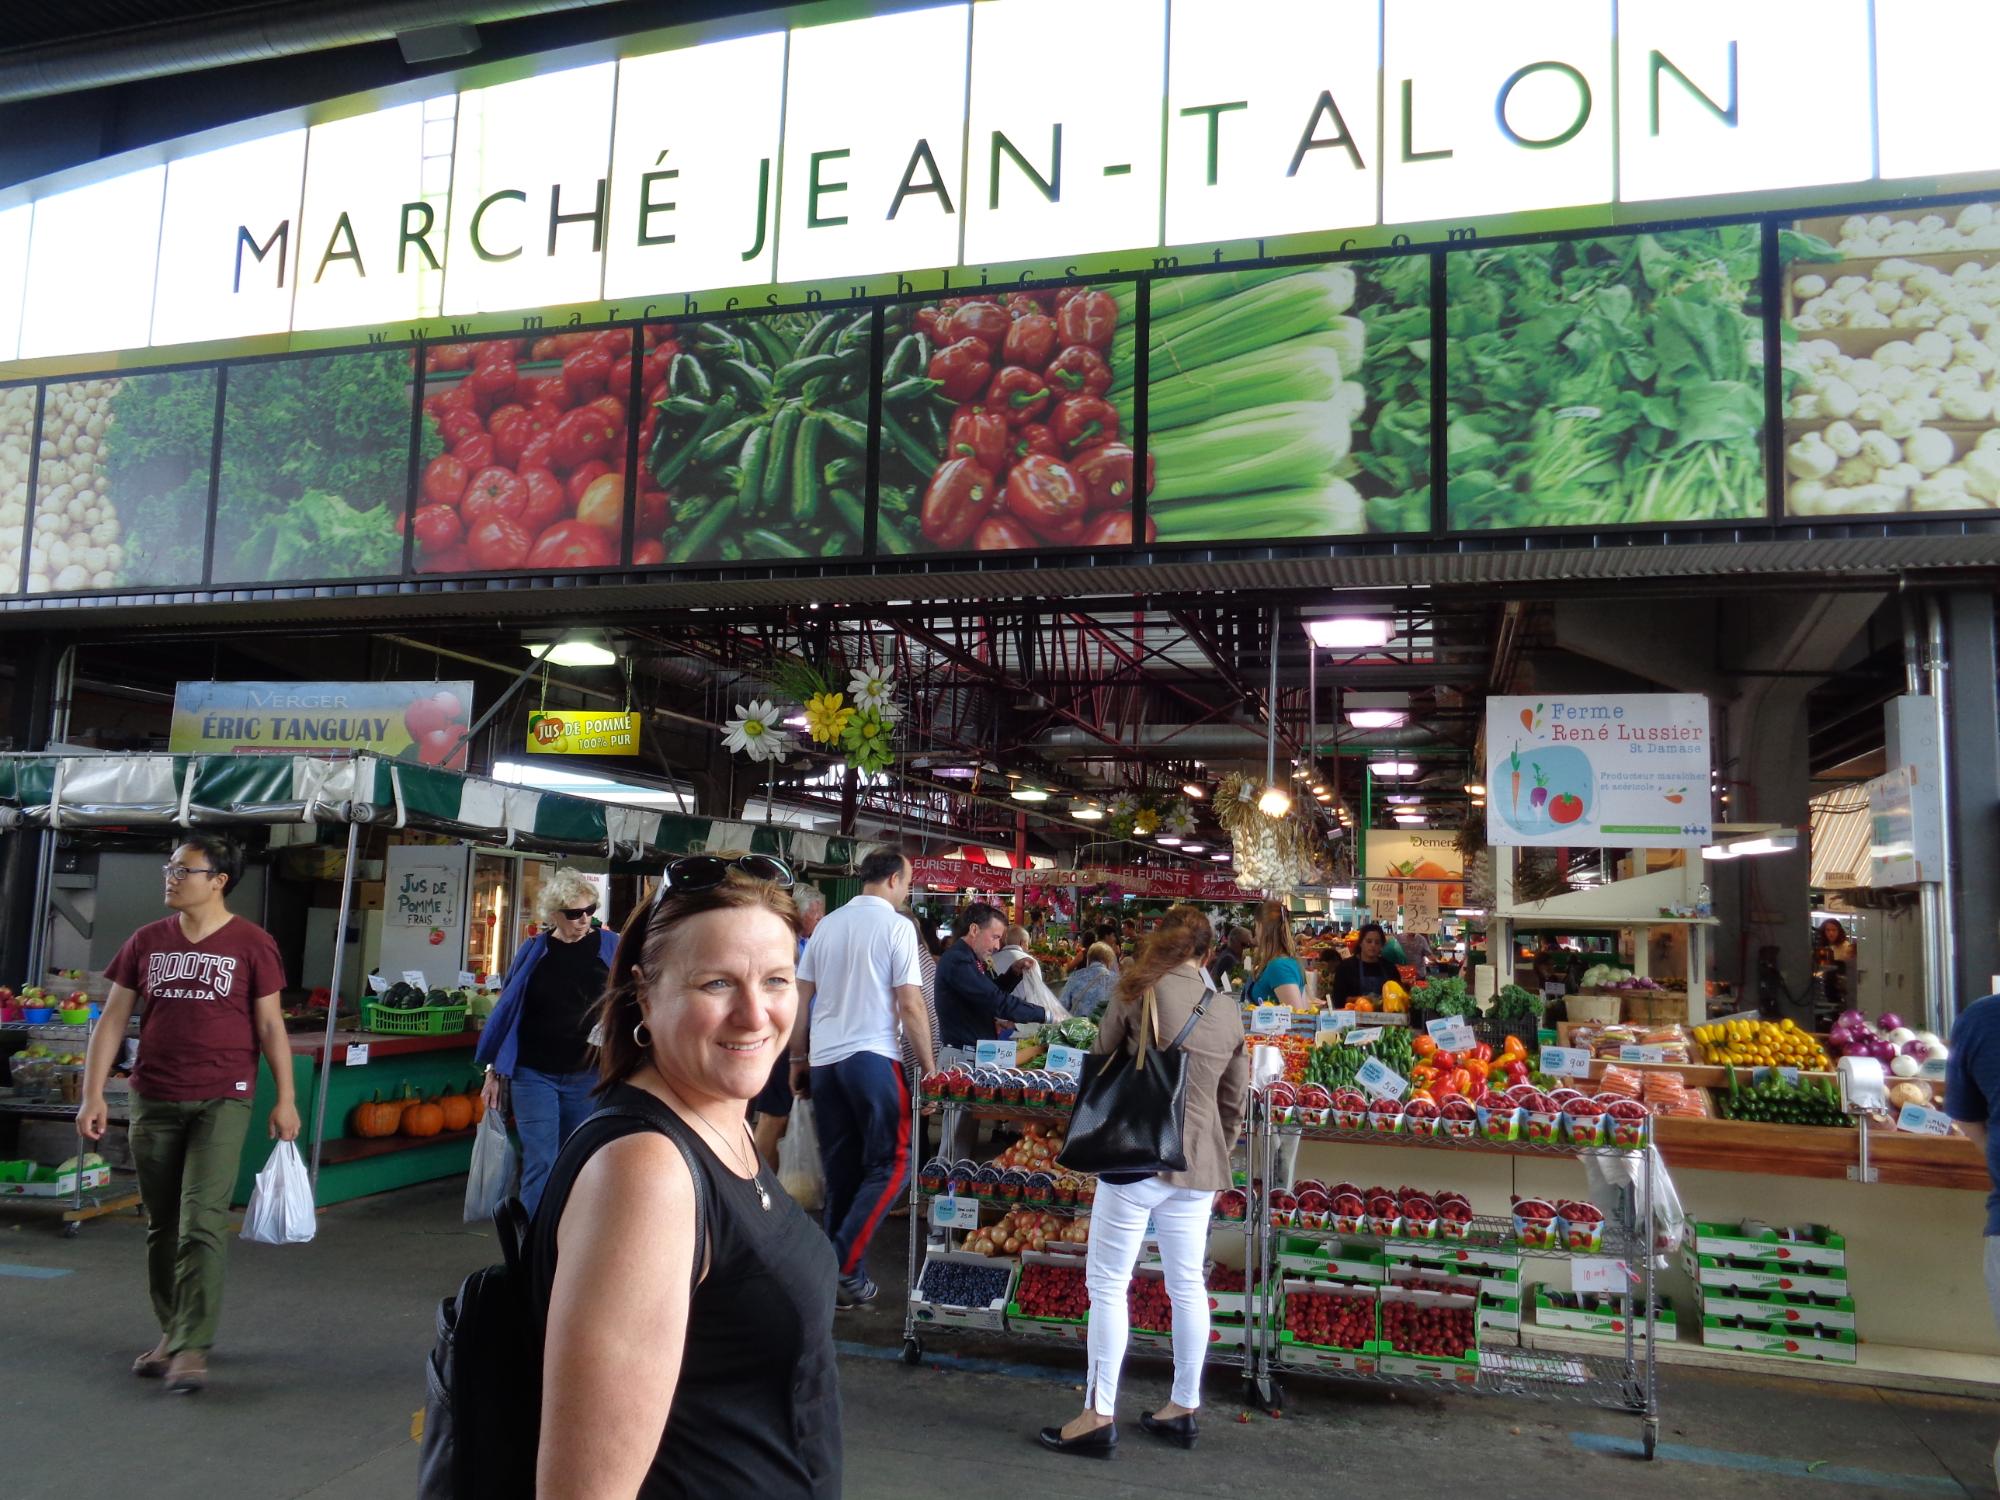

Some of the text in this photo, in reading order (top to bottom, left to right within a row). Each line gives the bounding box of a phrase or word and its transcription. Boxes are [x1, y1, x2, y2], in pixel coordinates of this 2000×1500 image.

[232, 39, 1738, 294] MARCHÉ JEAN-TALON
[250, 690, 349, 709] VERGER
[1551, 703, 1624, 720] Ferme
[202, 712, 390, 742] ÉRIC TANGUAY
[564, 722, 580, 736] DE
[585, 716, 632, 734] POMME
[1551, 724, 1703, 741] René Lussier
[578, 734, 632, 751] 100% PUR
[1647, 743, 1702, 754] Damase
[1600, 772, 1656, 781] Producteur
[147, 952, 236, 997] ROOTS
[153, 988, 215, 1000] CANADA
